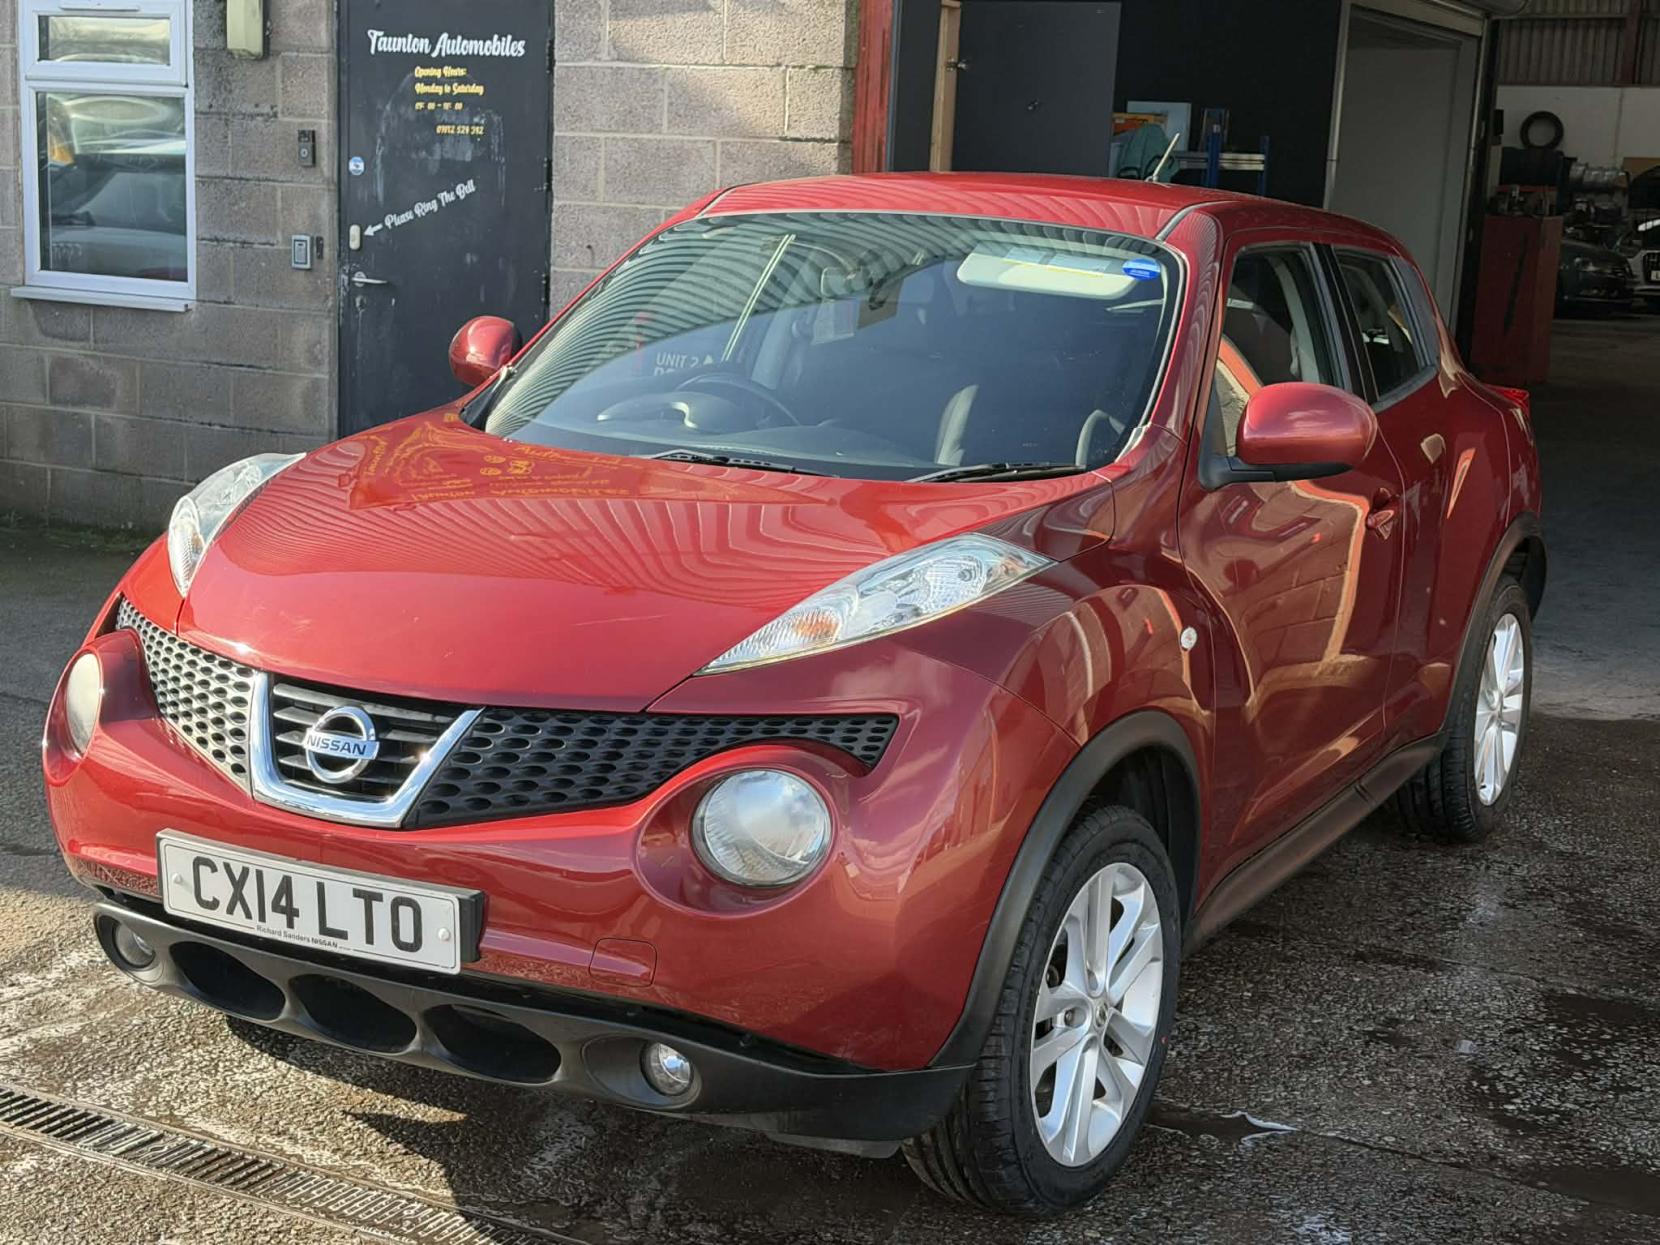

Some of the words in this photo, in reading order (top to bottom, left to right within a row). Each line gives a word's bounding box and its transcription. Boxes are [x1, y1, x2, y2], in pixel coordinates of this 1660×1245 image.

[367, 29, 431, 55] Taunton
[431, 32, 526, 58] Automobiles
[414, 82, 443, 96] Monday
[452, 82, 485, 96] Saturday
[384, 210, 414, 229] Please
[414, 199, 438, 218] Ring
[437, 190, 456, 207] The
[455, 179, 476, 200] Bell
[656, 351, 688, 369] UNIT
[306, 734, 367, 755] NISSAN
[192, 855, 300, 929] CX14
[315, 880, 423, 953] LTO
[256, 924, 282, 937] Richard
[282, 929, 310, 943] Sanders
[311, 936, 338, 949] NISSAN
